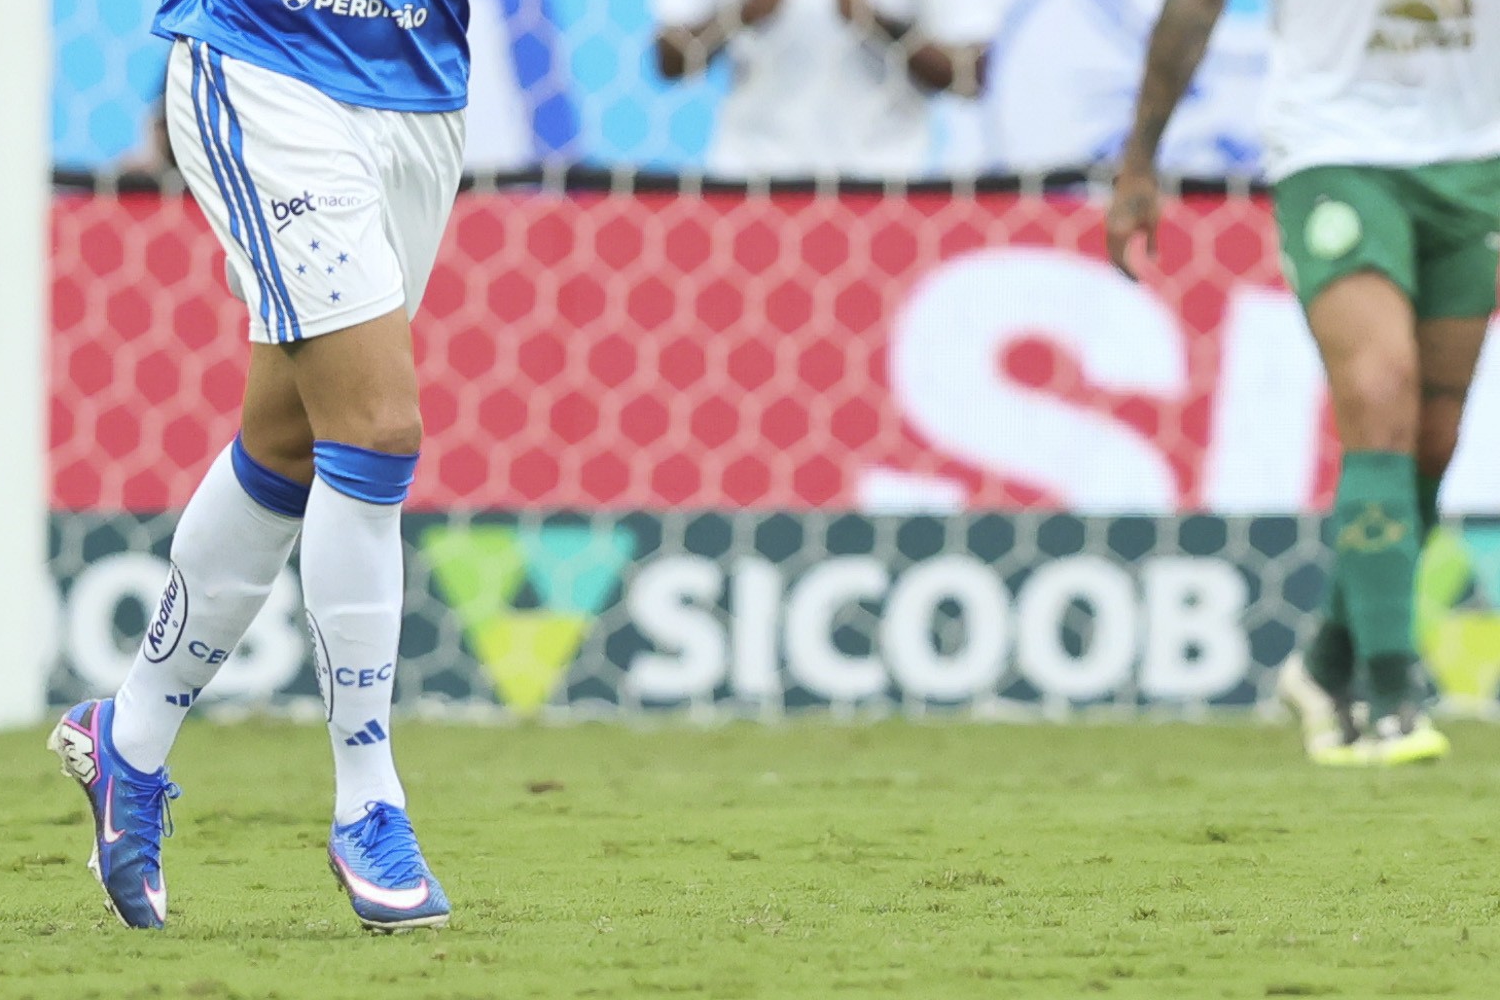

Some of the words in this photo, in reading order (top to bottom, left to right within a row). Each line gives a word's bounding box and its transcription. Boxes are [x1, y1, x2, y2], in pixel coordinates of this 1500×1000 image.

[147, 572, 180, 654] Kodilar
[624, 553, 1252, 700] SICOOB
[336, 663, 392, 688] CEC
